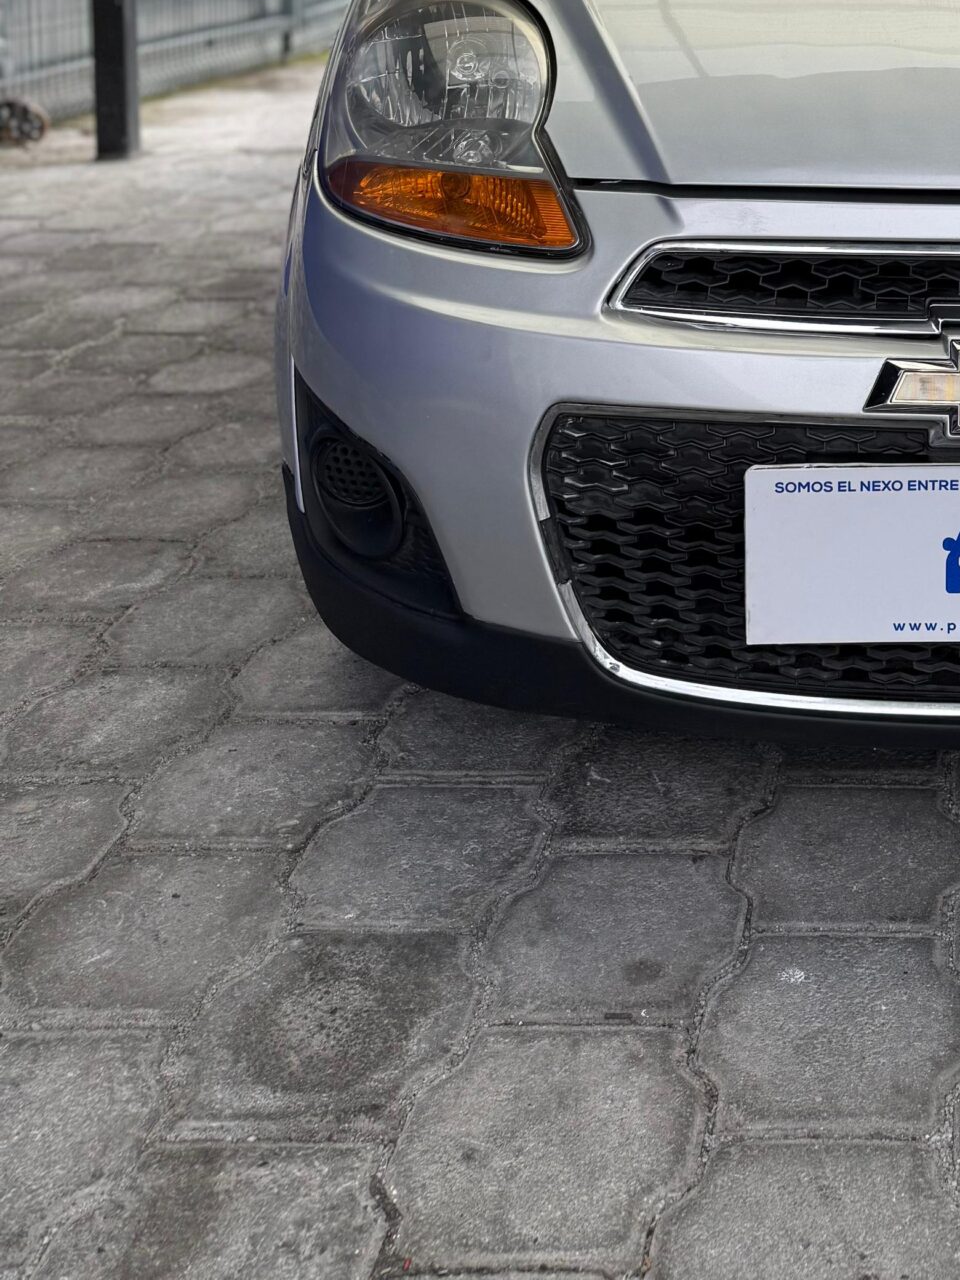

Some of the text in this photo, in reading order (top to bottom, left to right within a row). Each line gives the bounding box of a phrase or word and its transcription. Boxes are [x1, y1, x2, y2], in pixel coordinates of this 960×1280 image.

[774, 480, 834, 494] SOMOS
[837, 480, 856, 493] EL
[859, 479, 903, 493] NEXO
[907, 479, 959, 493] ENTRE
